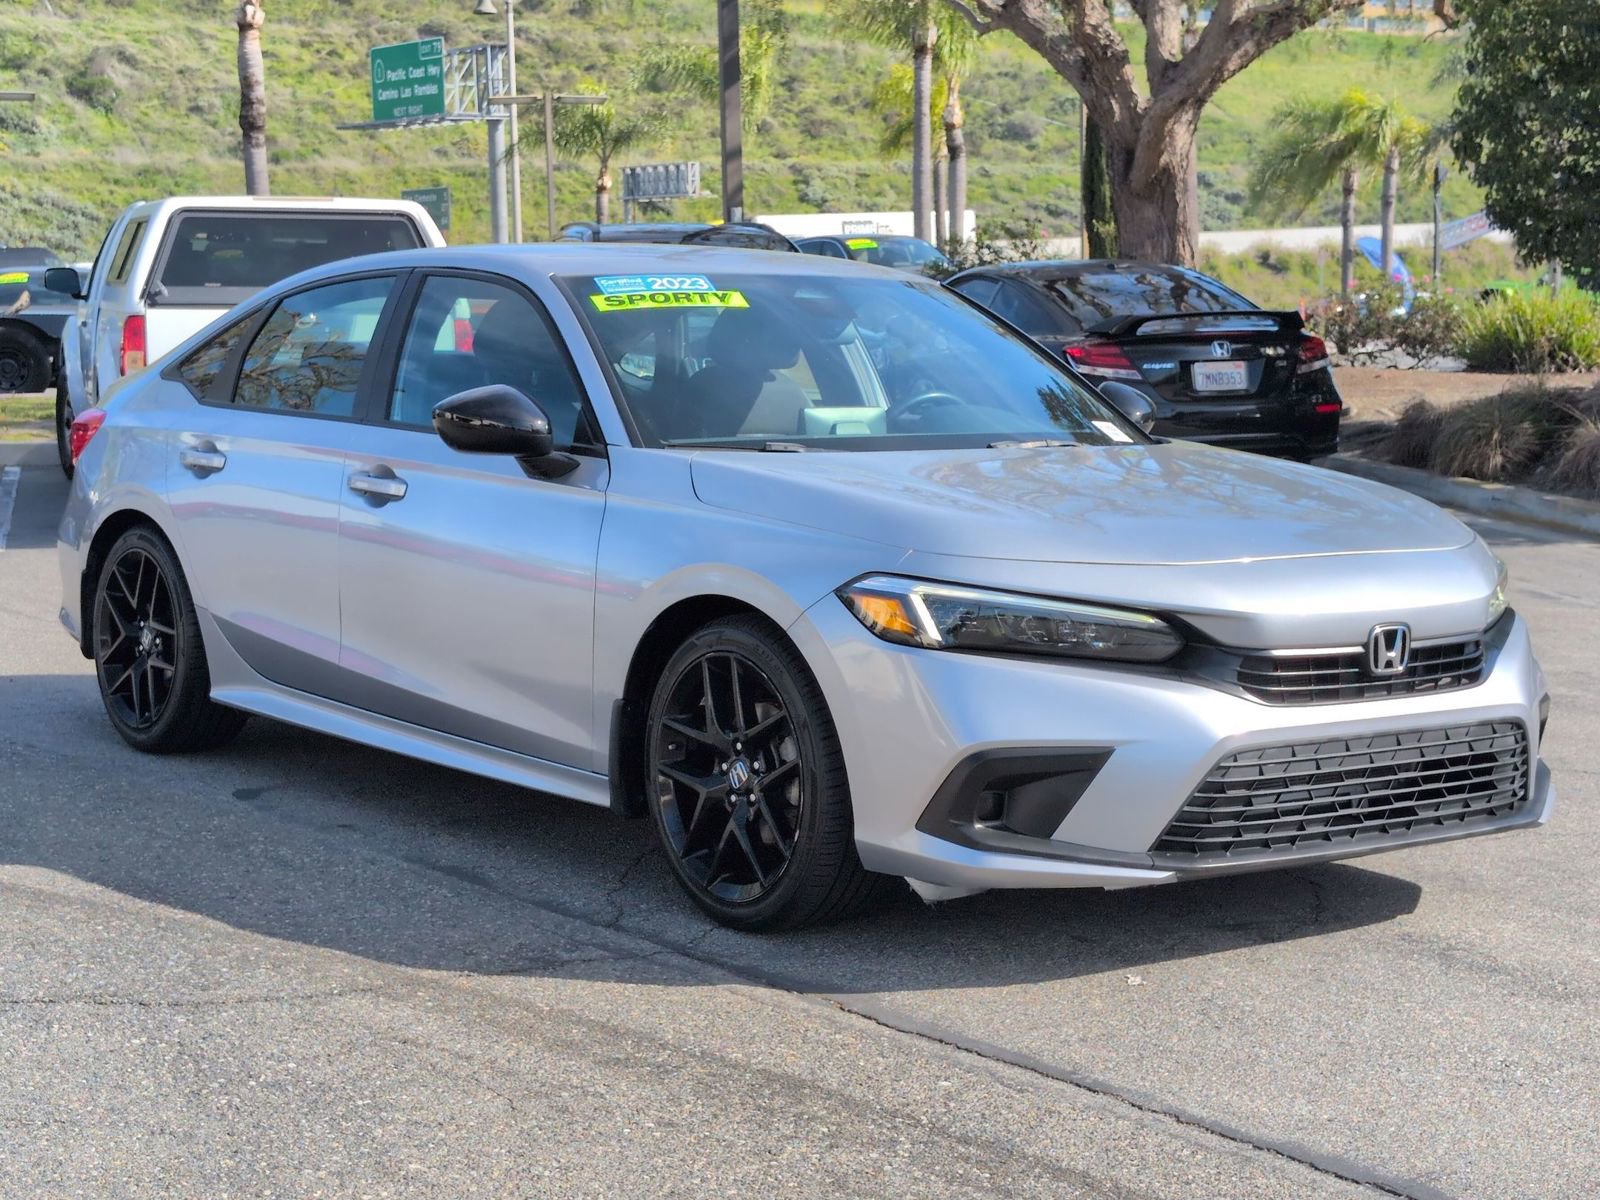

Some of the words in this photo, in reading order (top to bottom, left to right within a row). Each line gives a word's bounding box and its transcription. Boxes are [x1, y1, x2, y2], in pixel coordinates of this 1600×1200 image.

[386, 69, 406, 82] Pacific
[408, 66, 426, 79] Coast
[427, 64, 441, 79] Hwy
[378, 88, 400, 101] Camino
[400, 86, 412, 98] Las
[649, 277, 709, 290] 2023
[604, 291, 731, 307] SPORTY
